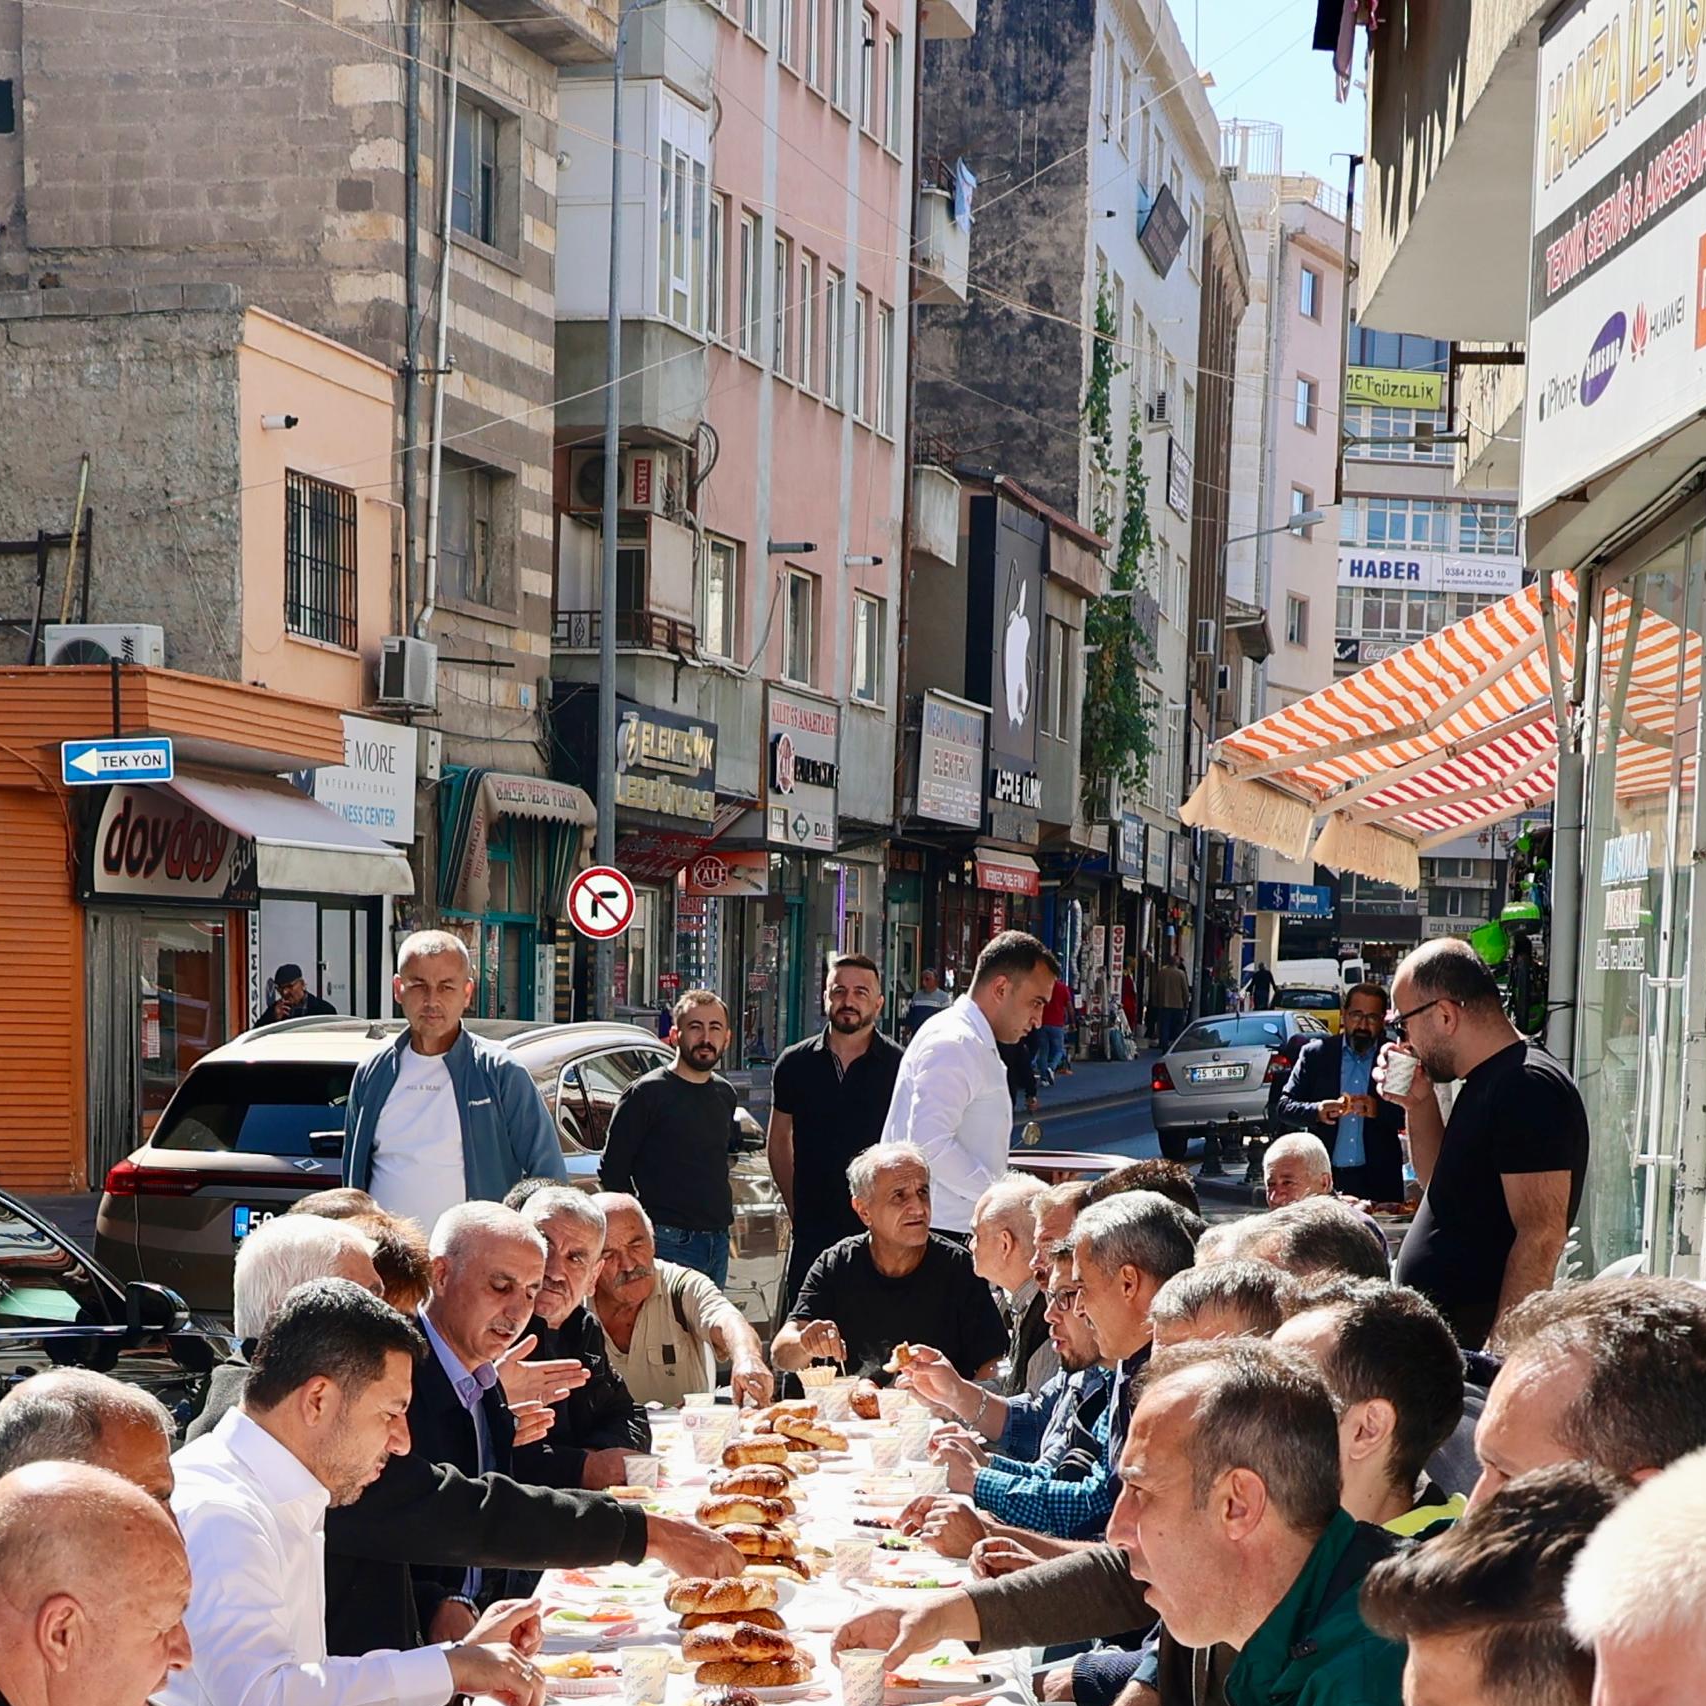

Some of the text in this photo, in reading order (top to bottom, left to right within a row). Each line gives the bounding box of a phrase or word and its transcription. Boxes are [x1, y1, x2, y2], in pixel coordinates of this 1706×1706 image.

[1545, 13, 1622, 190] HAMZA
[1546, 211, 1588, 296] TEKNİK
[1587, 173, 1632, 264] SERVİS
[1632, 170, 1644, 229] &
[1649, 295, 1686, 342] HUAWEI
[1586, 338, 1621, 382] SAMSUNG
[1547, 373, 1578, 418] iPhone
[1350, 559, 1420, 581] HABER
[1445, 567, 1506, 578] 0384 212 43 10
[121, 635, 134, 664] elik
[101, 752, 162, 768] TEK YÖN
[354, 740, 396, 774] MORE
[995, 767, 1021, 803] APPLE
[364, 806, 396, 827] CENTER
[104, 795, 230, 882] doydoy
[693, 866, 728, 885] KALE
[1213, 1068, 1222, 1077] SH
[237, 1223, 247, 1232] TR
